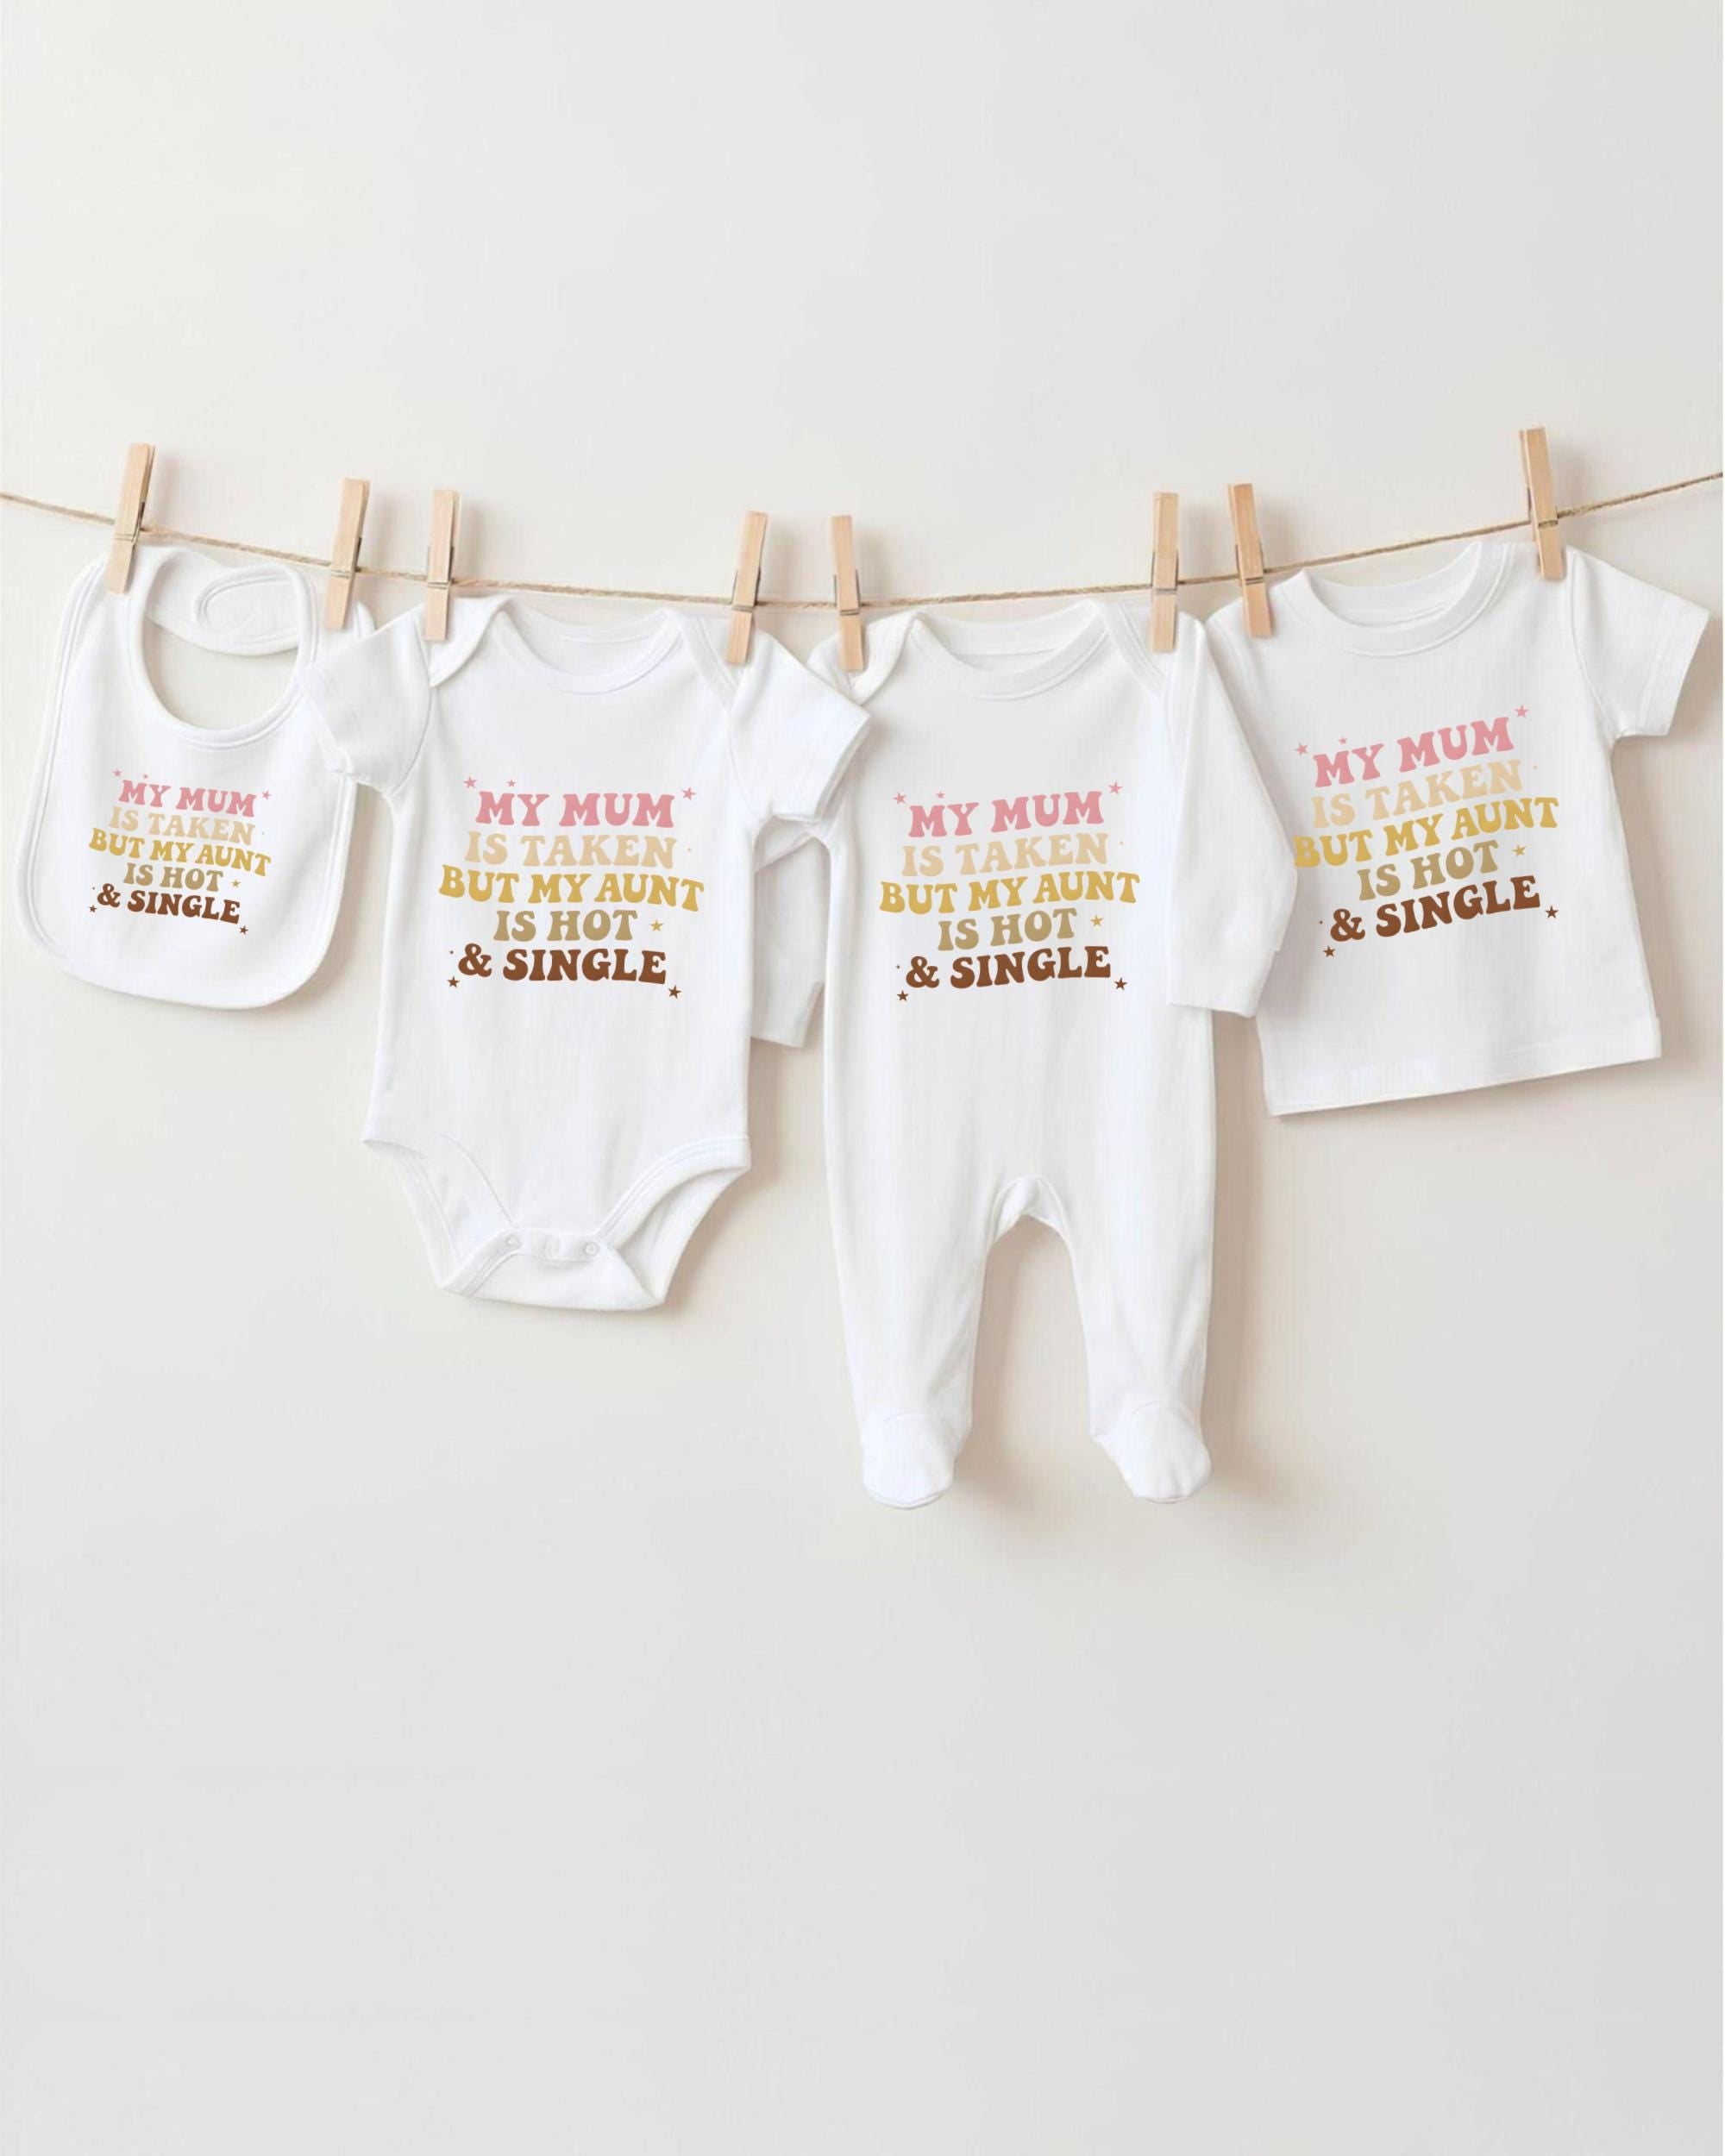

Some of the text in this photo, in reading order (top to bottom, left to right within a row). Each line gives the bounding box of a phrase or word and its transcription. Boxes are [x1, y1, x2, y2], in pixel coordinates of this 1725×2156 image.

[1312, 717, 1515, 788] MY MUM
[118, 779, 257, 818] MY MUM
[474, 790, 675, 829] MY MUM
[907, 790, 1105, 838] MY MUM
[1310, 758, 1523, 830] IS TAKEN
[109, 805, 256, 845] IS TAKEN
[1292, 796, 1559, 868] BUT MY AUNT
[88, 827, 273, 877] BUT MY AUNT
[463, 830, 678, 870] IS TAKEN
[901, 832, 1109, 877] IS TAKEN
[1356, 839, 1499, 902] IS HOT
[122, 862, 224, 892] IS HOT
[437, 864, 705, 912] BUT MY AUNT
[879, 870, 1141, 916] BUT MY AUNT
[96, 882, 241, 925] & SINGLE
[492, 909, 638, 943] IS HOT
[1329, 874, 1541, 943] & SINGLE
[938, 907, 1077, 952] IS HOT
[457, 942, 667, 985] & SINGLE
[905, 944, 1112, 990] & SINGLE
